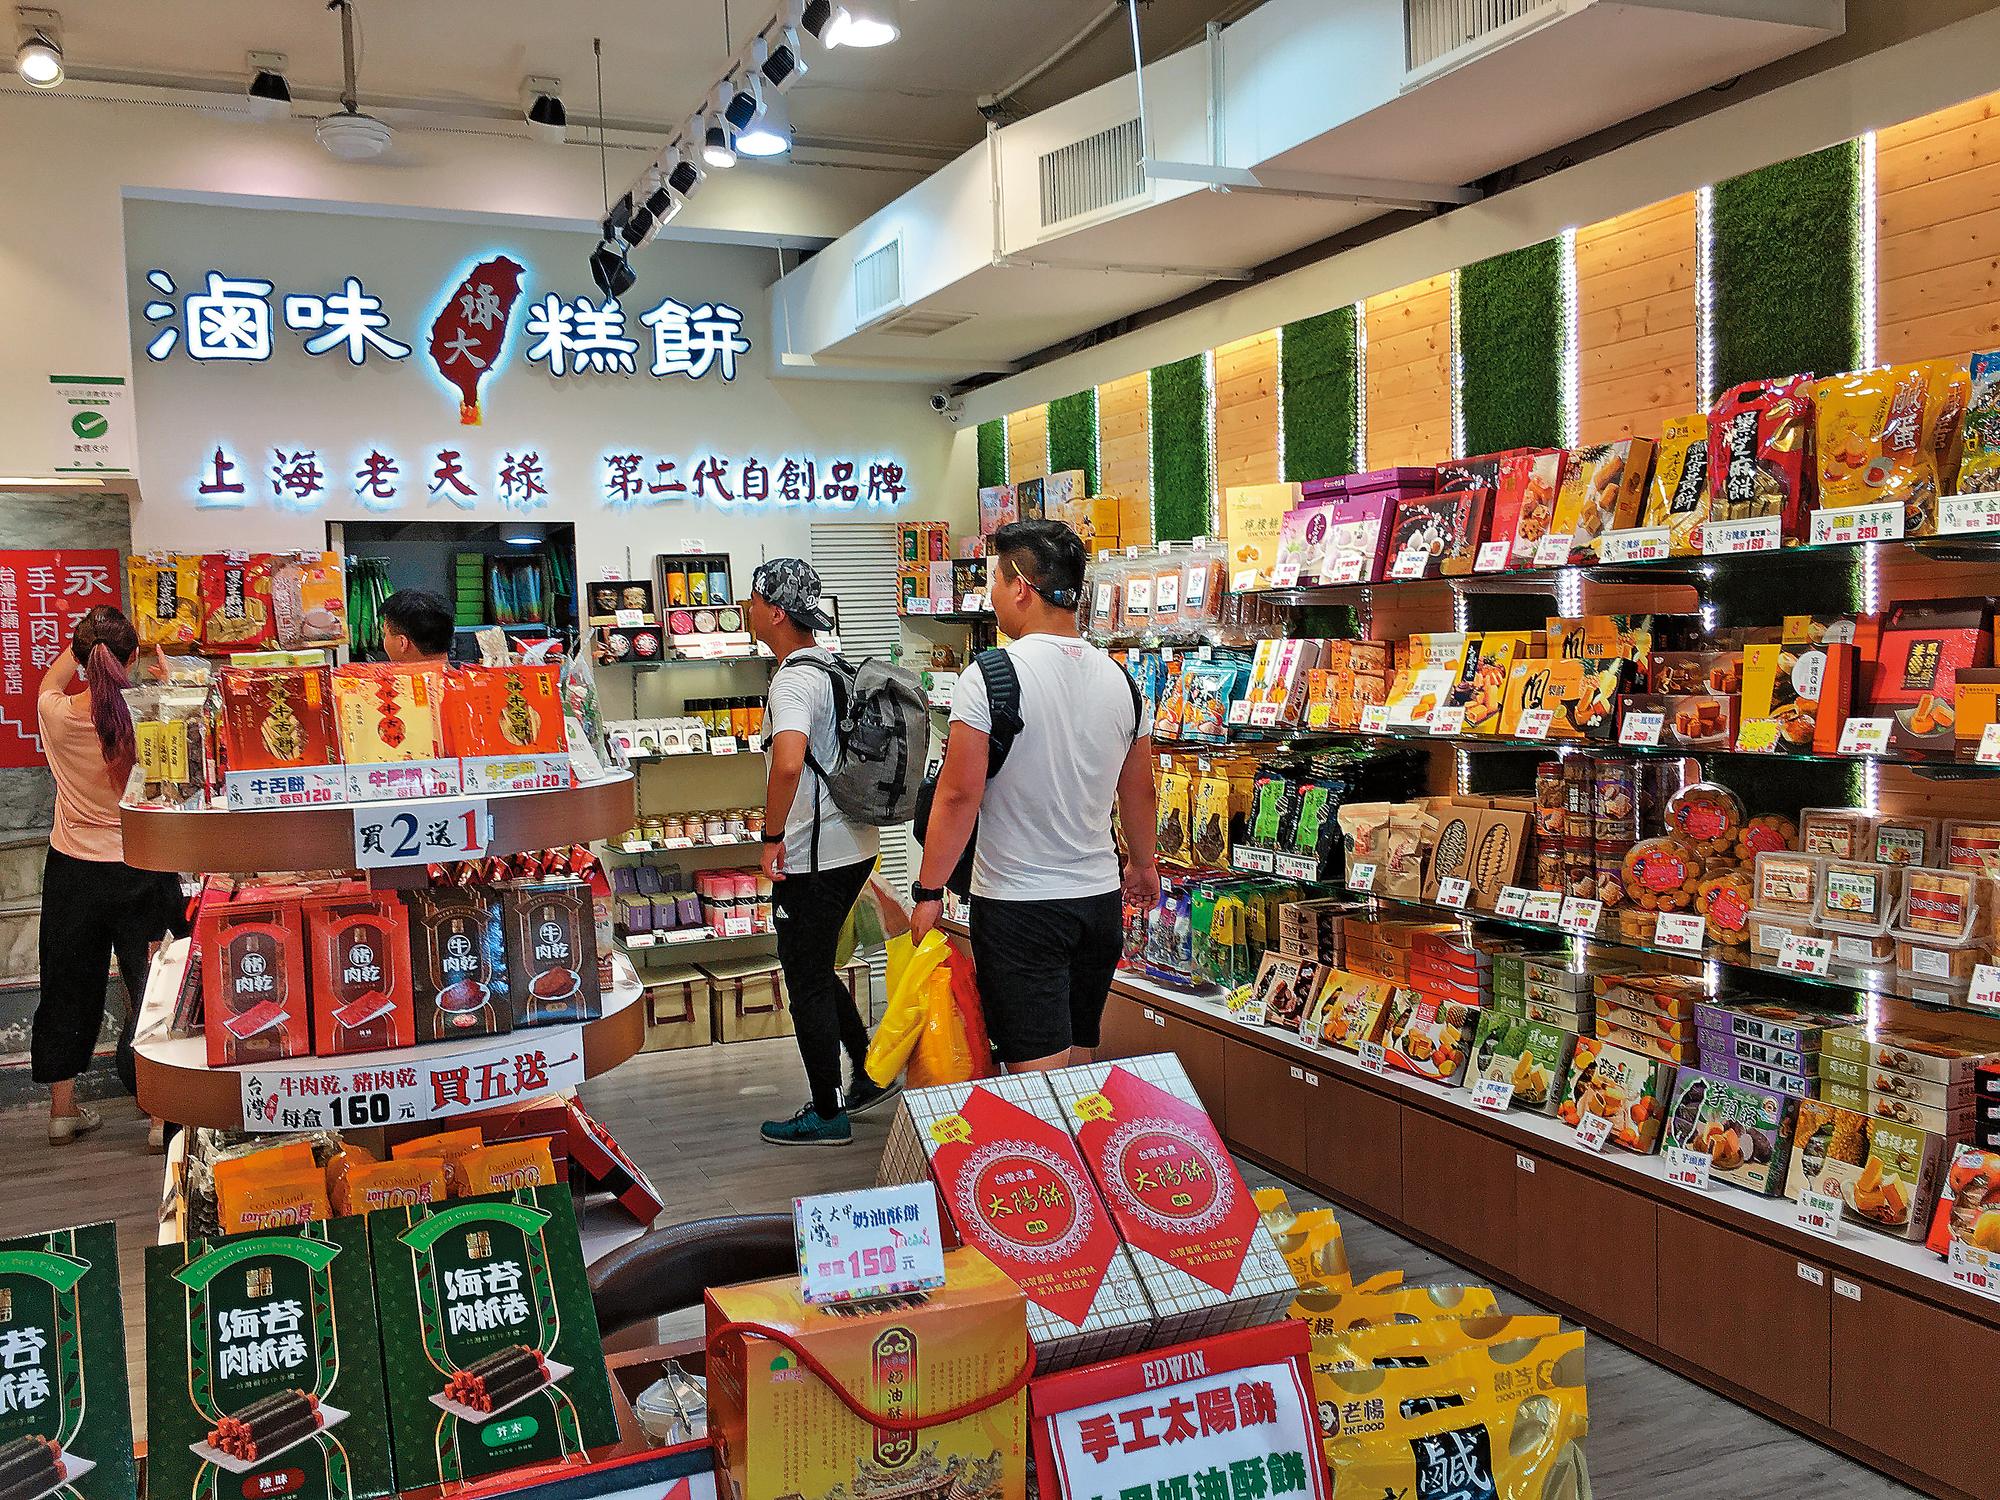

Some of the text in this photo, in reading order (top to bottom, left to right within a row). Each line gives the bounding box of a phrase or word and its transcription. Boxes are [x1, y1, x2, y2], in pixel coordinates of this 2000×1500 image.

[143, 268, 413, 365] 滷味
[525, 292, 752, 380] 糕餅
[198, 446, 549, 501] 上海老天祿
[603, 453, 907, 504] 第二代自創品牌
[304, 788, 332, 804] 120
[535, 774, 561, 788] 120
[360, 808, 484, 858] 買2送1
[442, 955, 479, 973] 肉乾
[535, 942, 570, 961] 肉乾
[235, 974, 274, 994] 肉乾
[343, 965, 381, 984] 肉乾
[430, 1050, 581, 1112] 買五送一
[281, 1093, 416, 1129] 每盒 160 元
[1132, 1156, 1207, 1192] 太陽餅
[851, 1203, 920, 1230] 奶油酥餅
[987, 1181, 1066, 1219] 太陽餅
[444, 1260, 523, 1301] 海苔
[848, 1245, 897, 1279] 150
[901, 1255, 916, 1271] 元
[217, 1299, 305, 1343] 海苔
[1141, 1350, 1207, 1389] EDWIN
[1077, 1379, 1278, 1464] 手工太陽餅
[1341, 1398, 1385, 1425] 老楊
[1090, 1450, 1307, 1500] 奶油酥餅
